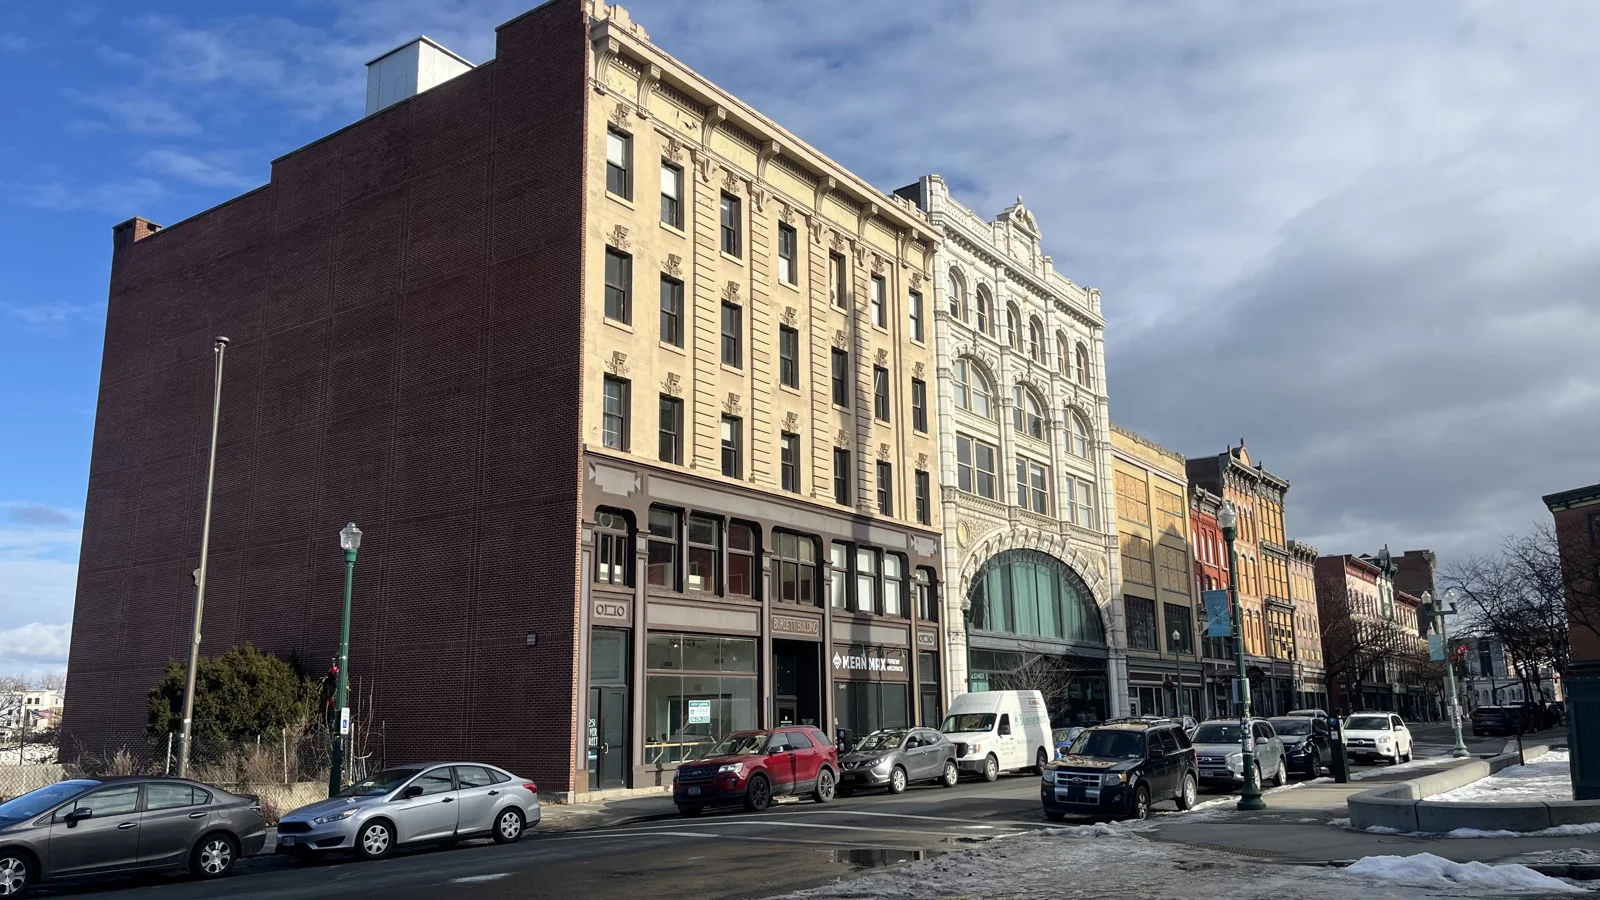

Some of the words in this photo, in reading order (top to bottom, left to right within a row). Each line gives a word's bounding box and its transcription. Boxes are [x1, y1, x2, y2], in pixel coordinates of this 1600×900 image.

[773, 617, 796, 630] BURDETT
[797, 620, 818, 633] BUILDING
[842, 655, 867, 670] MEAN
[868, 657, 887, 671] MAX
